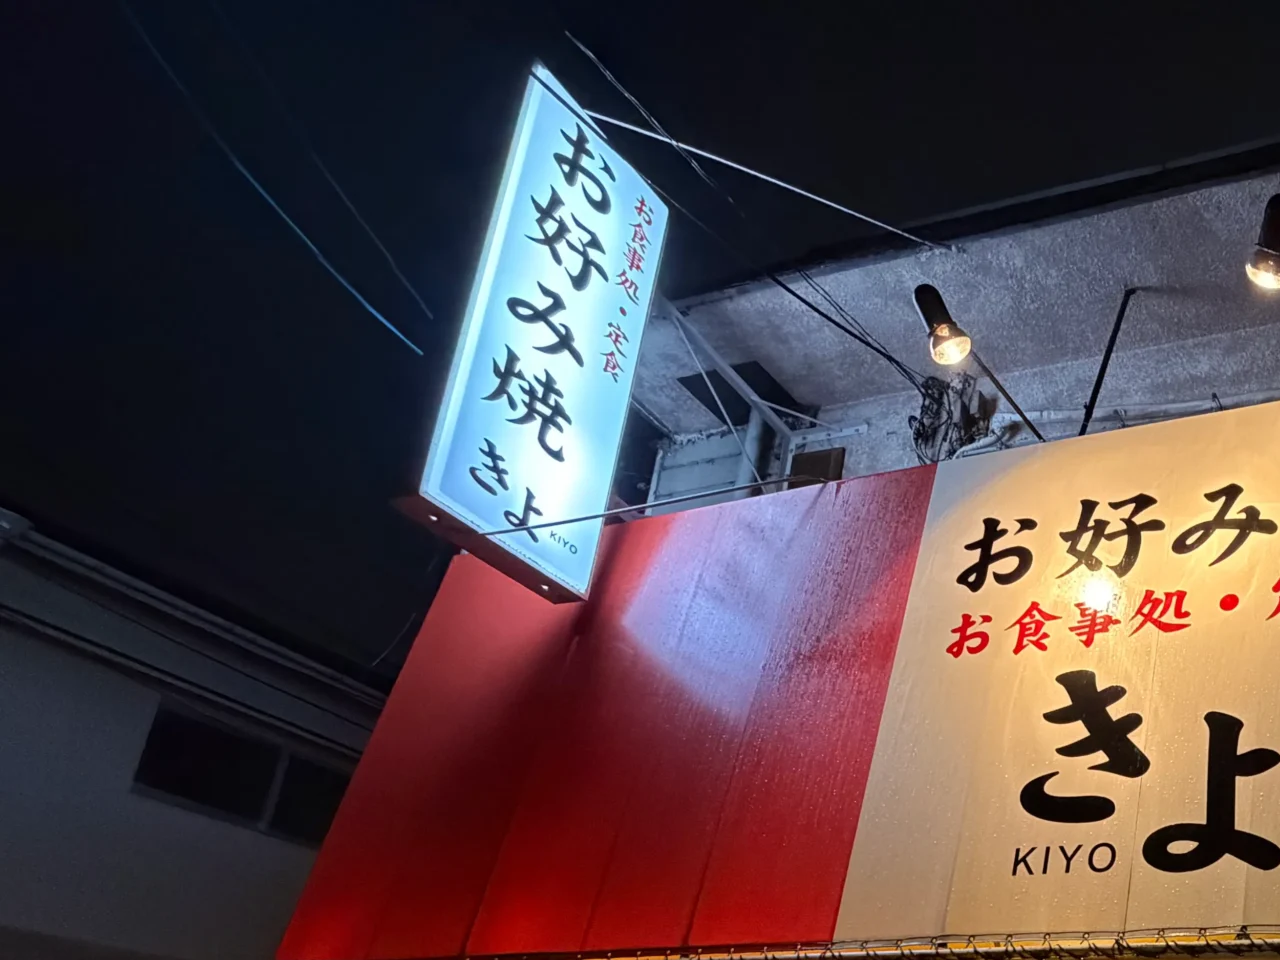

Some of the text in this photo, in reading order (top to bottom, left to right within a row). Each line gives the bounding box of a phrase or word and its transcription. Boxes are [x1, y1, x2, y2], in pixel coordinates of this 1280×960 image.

[480, 122, 617, 462] お好み焼
[550, 531, 578, 555] KIYO
[1011, 842, 1117, 876] KIYO
